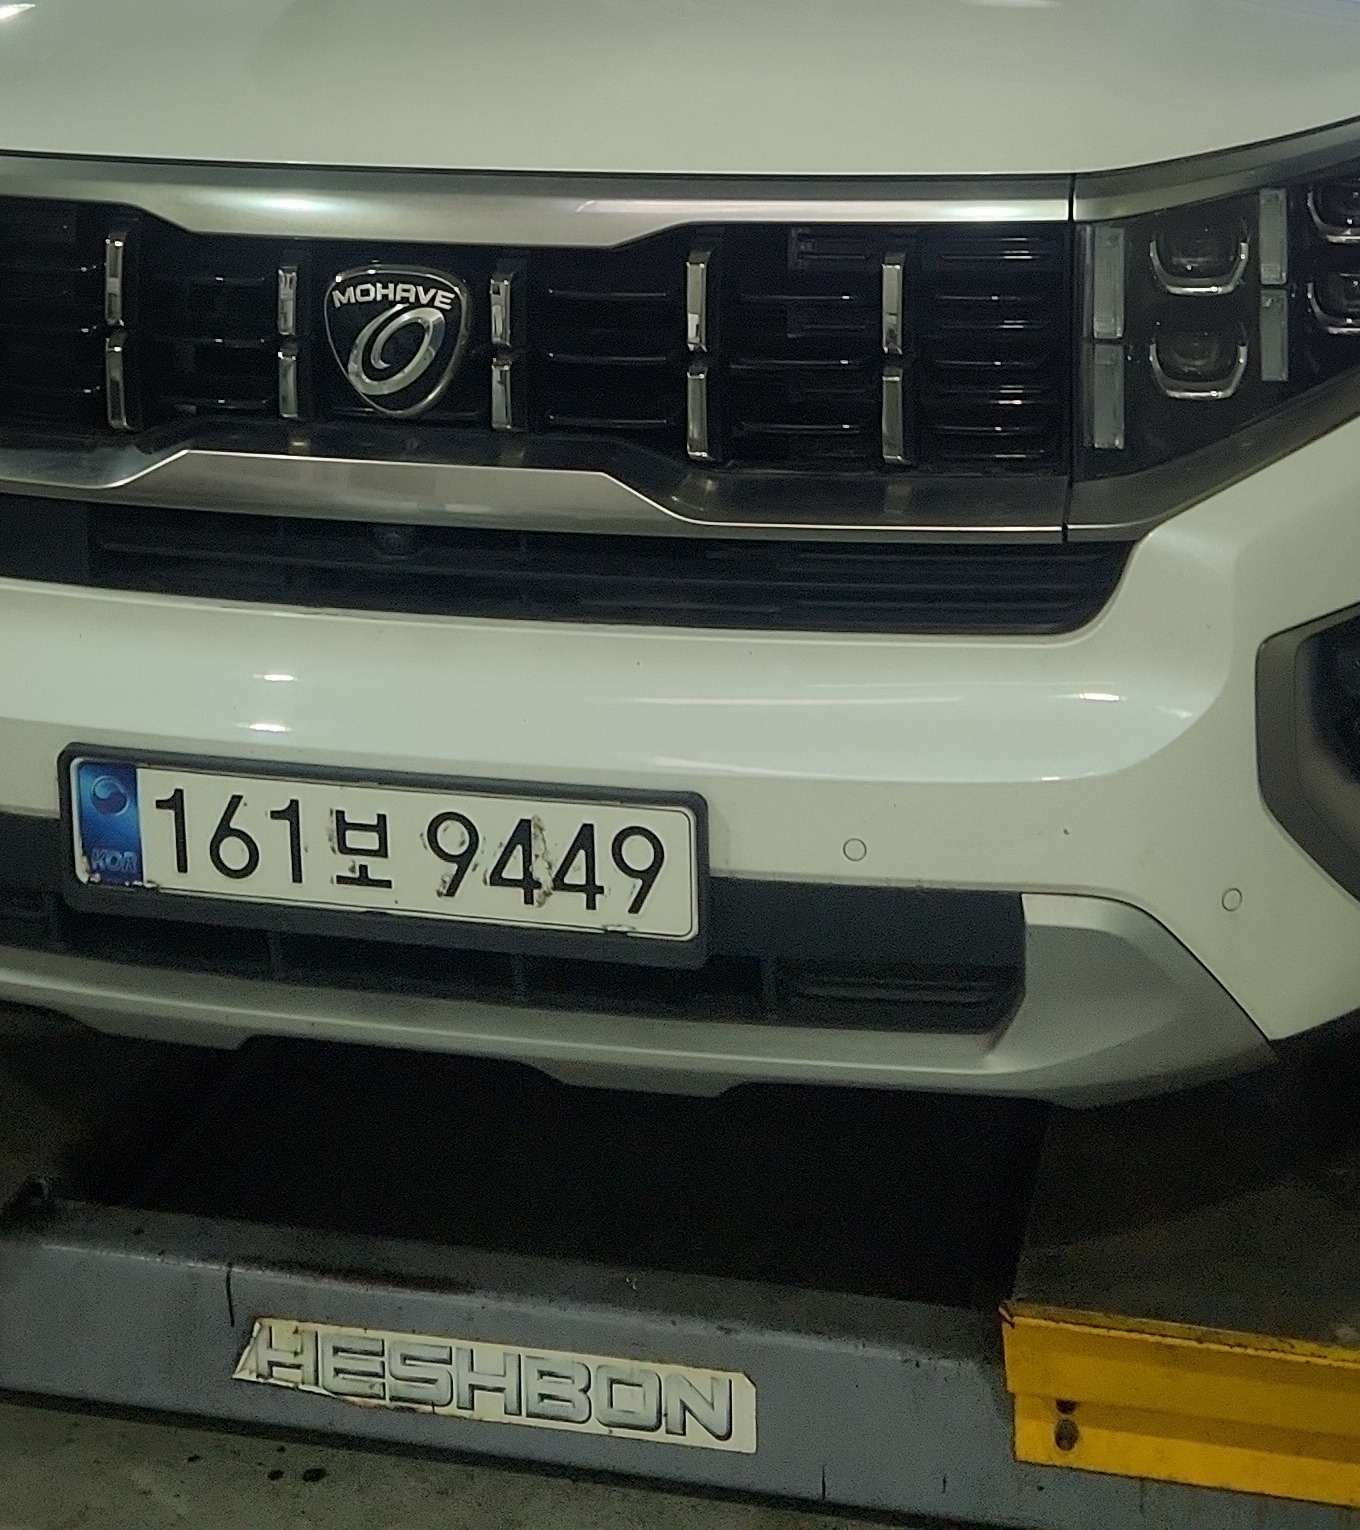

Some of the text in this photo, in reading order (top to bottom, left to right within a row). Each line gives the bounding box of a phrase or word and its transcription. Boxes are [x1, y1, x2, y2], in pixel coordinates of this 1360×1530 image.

[331, 282, 456, 310] MOHAVE
[91, 848, 138, 875] KOR
[155, 787, 665, 915] 161보 9449
[251, 1323, 734, 1442] HESHBON
